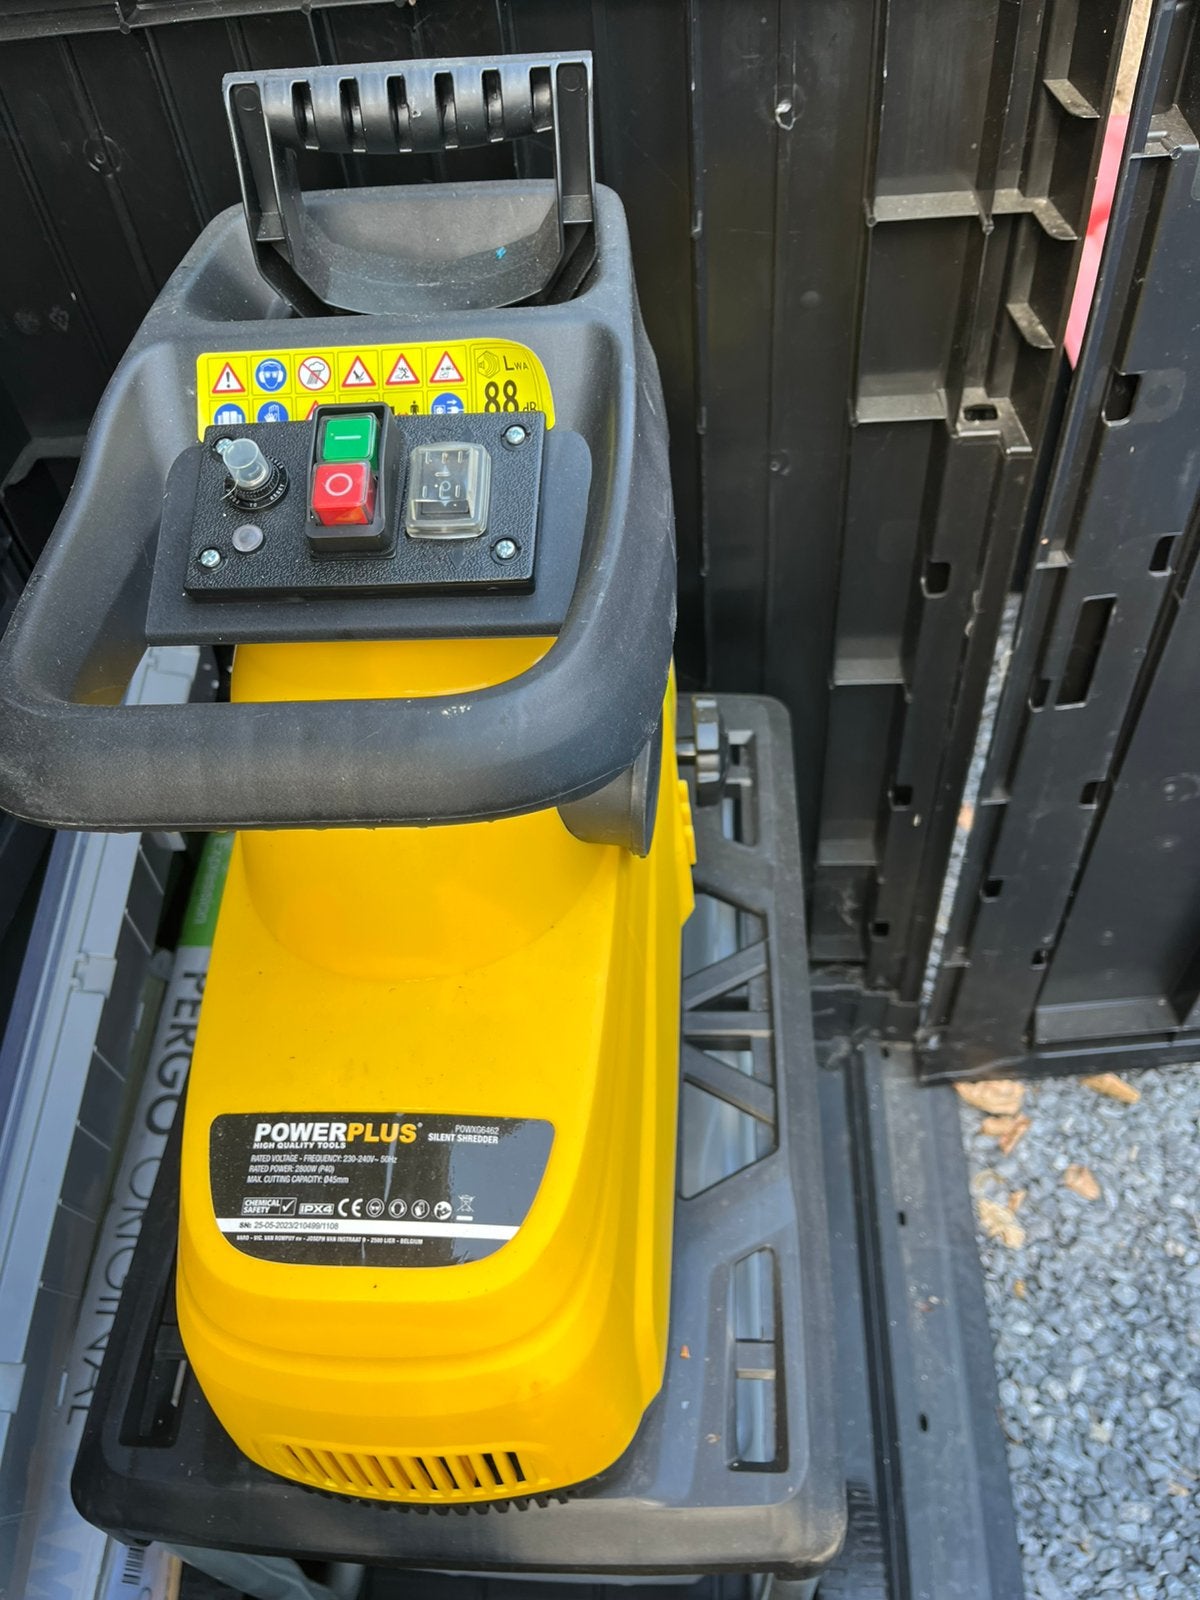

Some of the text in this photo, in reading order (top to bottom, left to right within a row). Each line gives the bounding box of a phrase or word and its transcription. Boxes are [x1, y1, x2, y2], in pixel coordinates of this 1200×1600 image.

[484, 379, 519, 413] 88
[147, 971, 207, 1135] PERGO
[254, 1122, 418, 1143] POWERPLUS
[427, 1132, 499, 1144] SILENT SHREDDER
[253, 1142, 347, 1150] HIGH QUALITY TOOLS
[250, 1154, 271, 1163] RATED
[271, 1154, 298, 1163] VOLTAGE
[248, 1165, 269, 1173] RATED
[263, 1175, 290, 1184] CUTTING
[244, 1199, 281, 1207] CHEMICAL
[243, 1206, 270, 1214] SAFETY
[301, 1204, 333, 1214] IPX4
